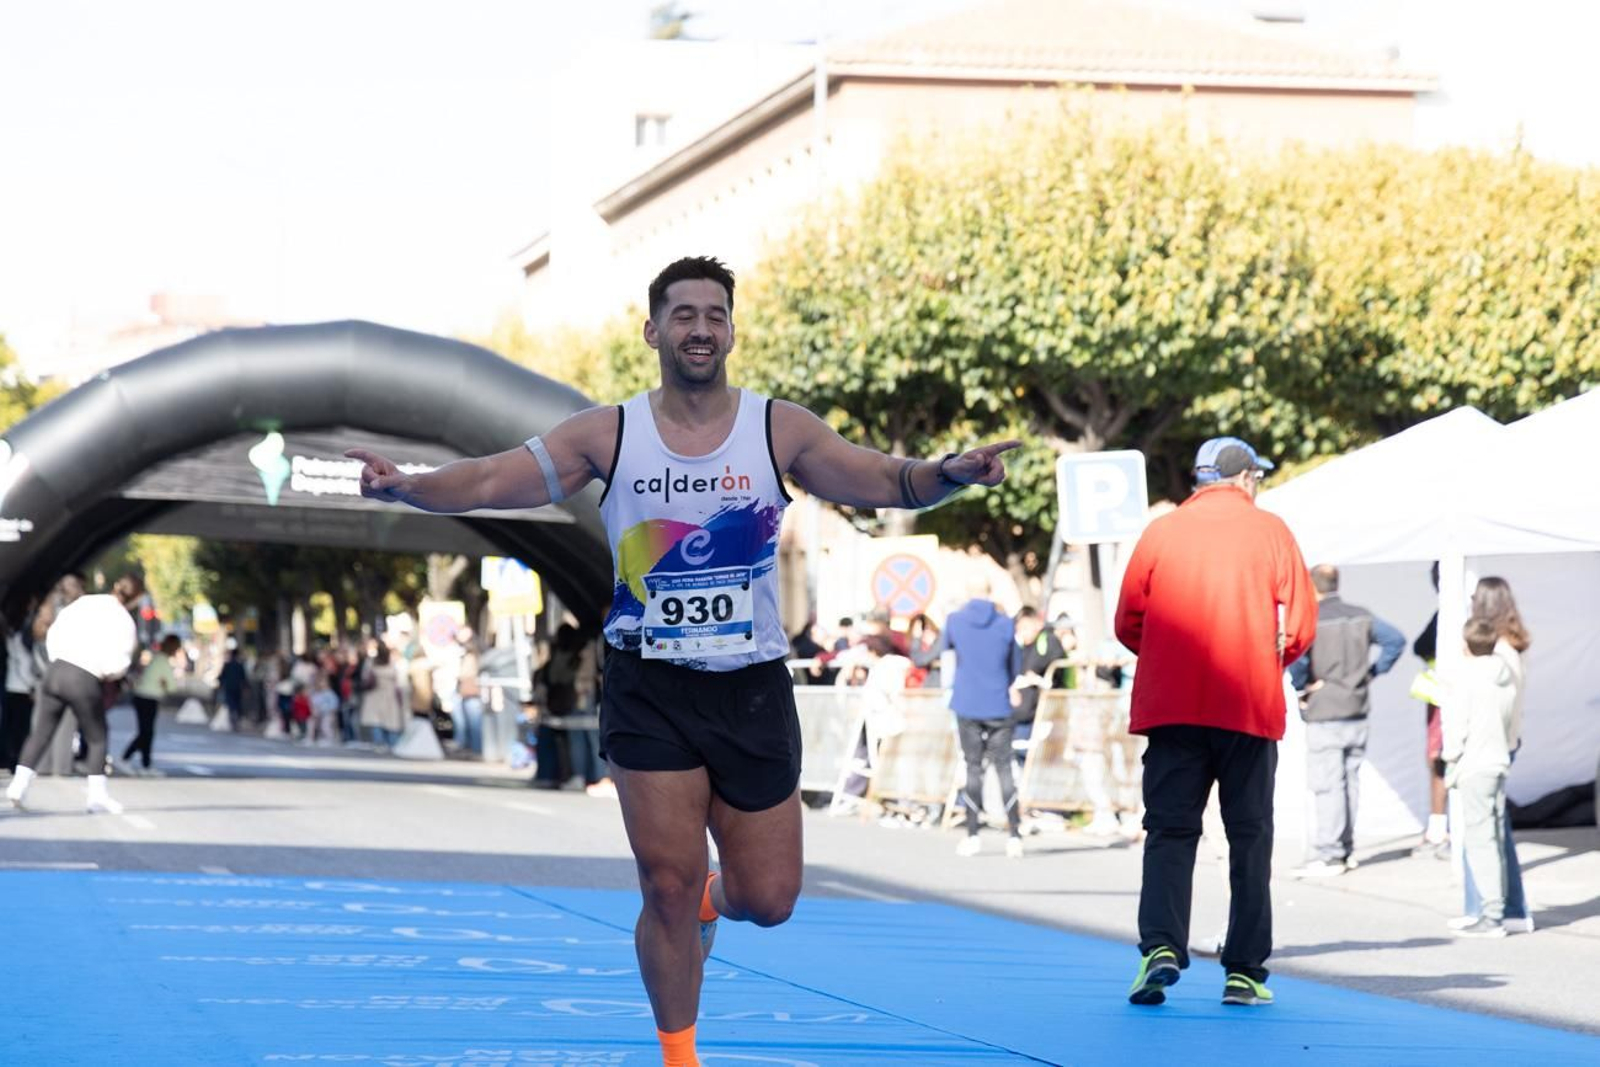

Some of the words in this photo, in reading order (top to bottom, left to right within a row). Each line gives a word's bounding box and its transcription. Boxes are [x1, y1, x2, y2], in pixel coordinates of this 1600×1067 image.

[633, 465, 750, 503] calderón
[1076, 463, 1128, 533] P
[661, 594, 734, 625] 930
